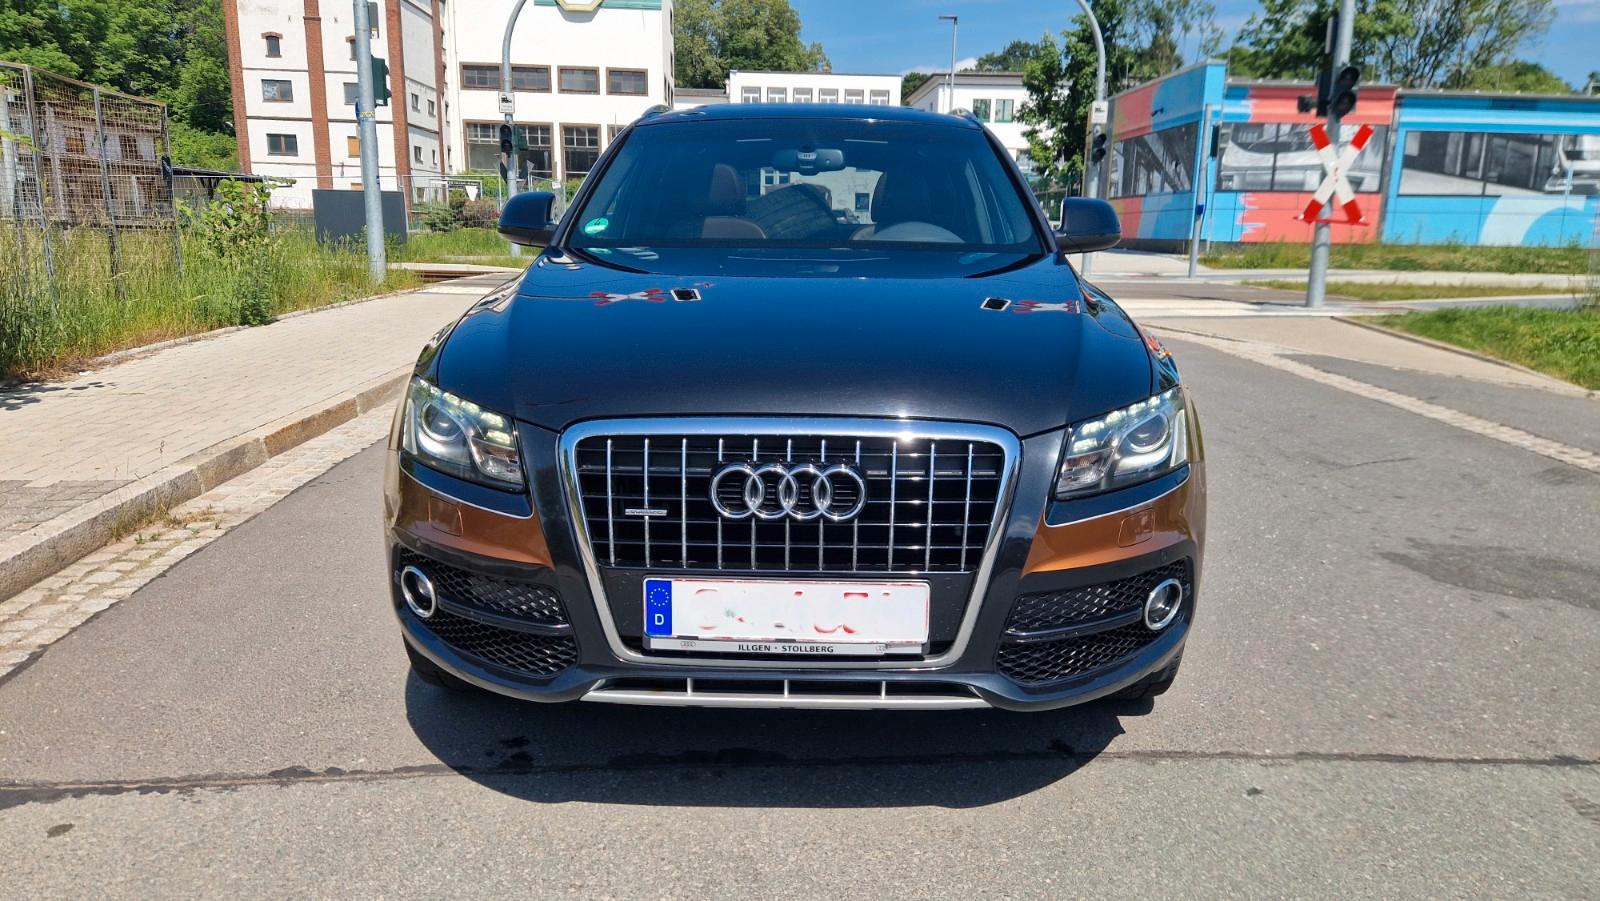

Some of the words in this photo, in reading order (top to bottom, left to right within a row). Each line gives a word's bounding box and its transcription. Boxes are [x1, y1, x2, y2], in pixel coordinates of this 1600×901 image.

[654, 613, 665, 626] D
[738, 644, 771, 652] ILLGEN
[781, 645, 834, 653] STOLLBERG
